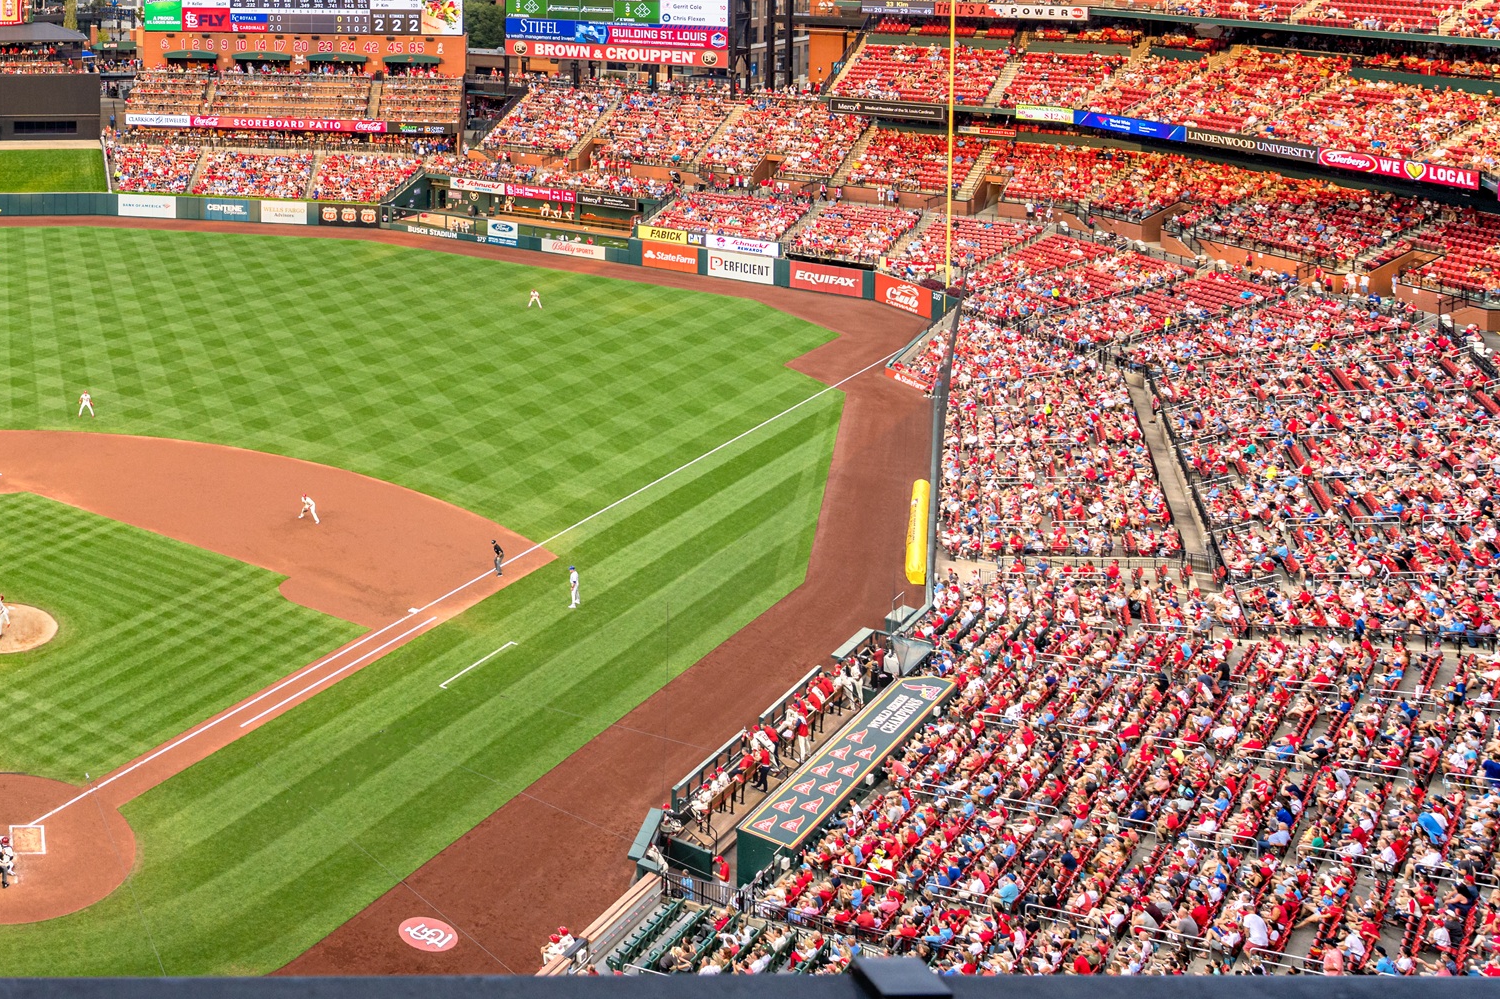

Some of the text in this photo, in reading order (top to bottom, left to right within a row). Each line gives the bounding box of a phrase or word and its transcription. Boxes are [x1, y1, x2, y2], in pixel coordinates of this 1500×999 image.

[936, 4, 974, 14] THAT'S
[1010, 8, 1068, 17] POWER
[198, 14, 226, 26] FLY
[374, 20, 418, 32] 2 2 2
[520, 18, 560, 34] STIFEL
[612, 29, 708, 42] BUILDING ST. LOUIS
[236, 40, 424, 54] 10 14 17 20 23 24 42 45 85
[534, 43, 590, 58] BROWN
[594, 48, 602, 58] &
[838, 103, 856, 112] Mercy
[194, 117, 382, 131] Coca-Cola SCOREBOARD PATIO Coca-Cola
[1188, 130, 1316, 159] LINDENWOOD UNIVERSITY
[1326, 151, 1475, 186] Dierbergs WE LOCAL
[466, 180, 500, 190] Schnucks
[582, 196, 598, 204] Mercy
[206, 203, 244, 212] CENTENE
[408, 226, 458, 240] BUSCH STADIUM
[496, 224, 510, 232] Ford
[650, 229, 704, 244] FABICK CAT
[552, 240, 594, 255] Bally SPORTS
[730, 239, 770, 249] Schnucks
[710, 256, 770, 276] PERFICIENT
[794, 270, 854, 288] EQUIFAX
[866, 709, 893, 729] WORLD
[880, 697, 924, 734] CHAMPIONS
